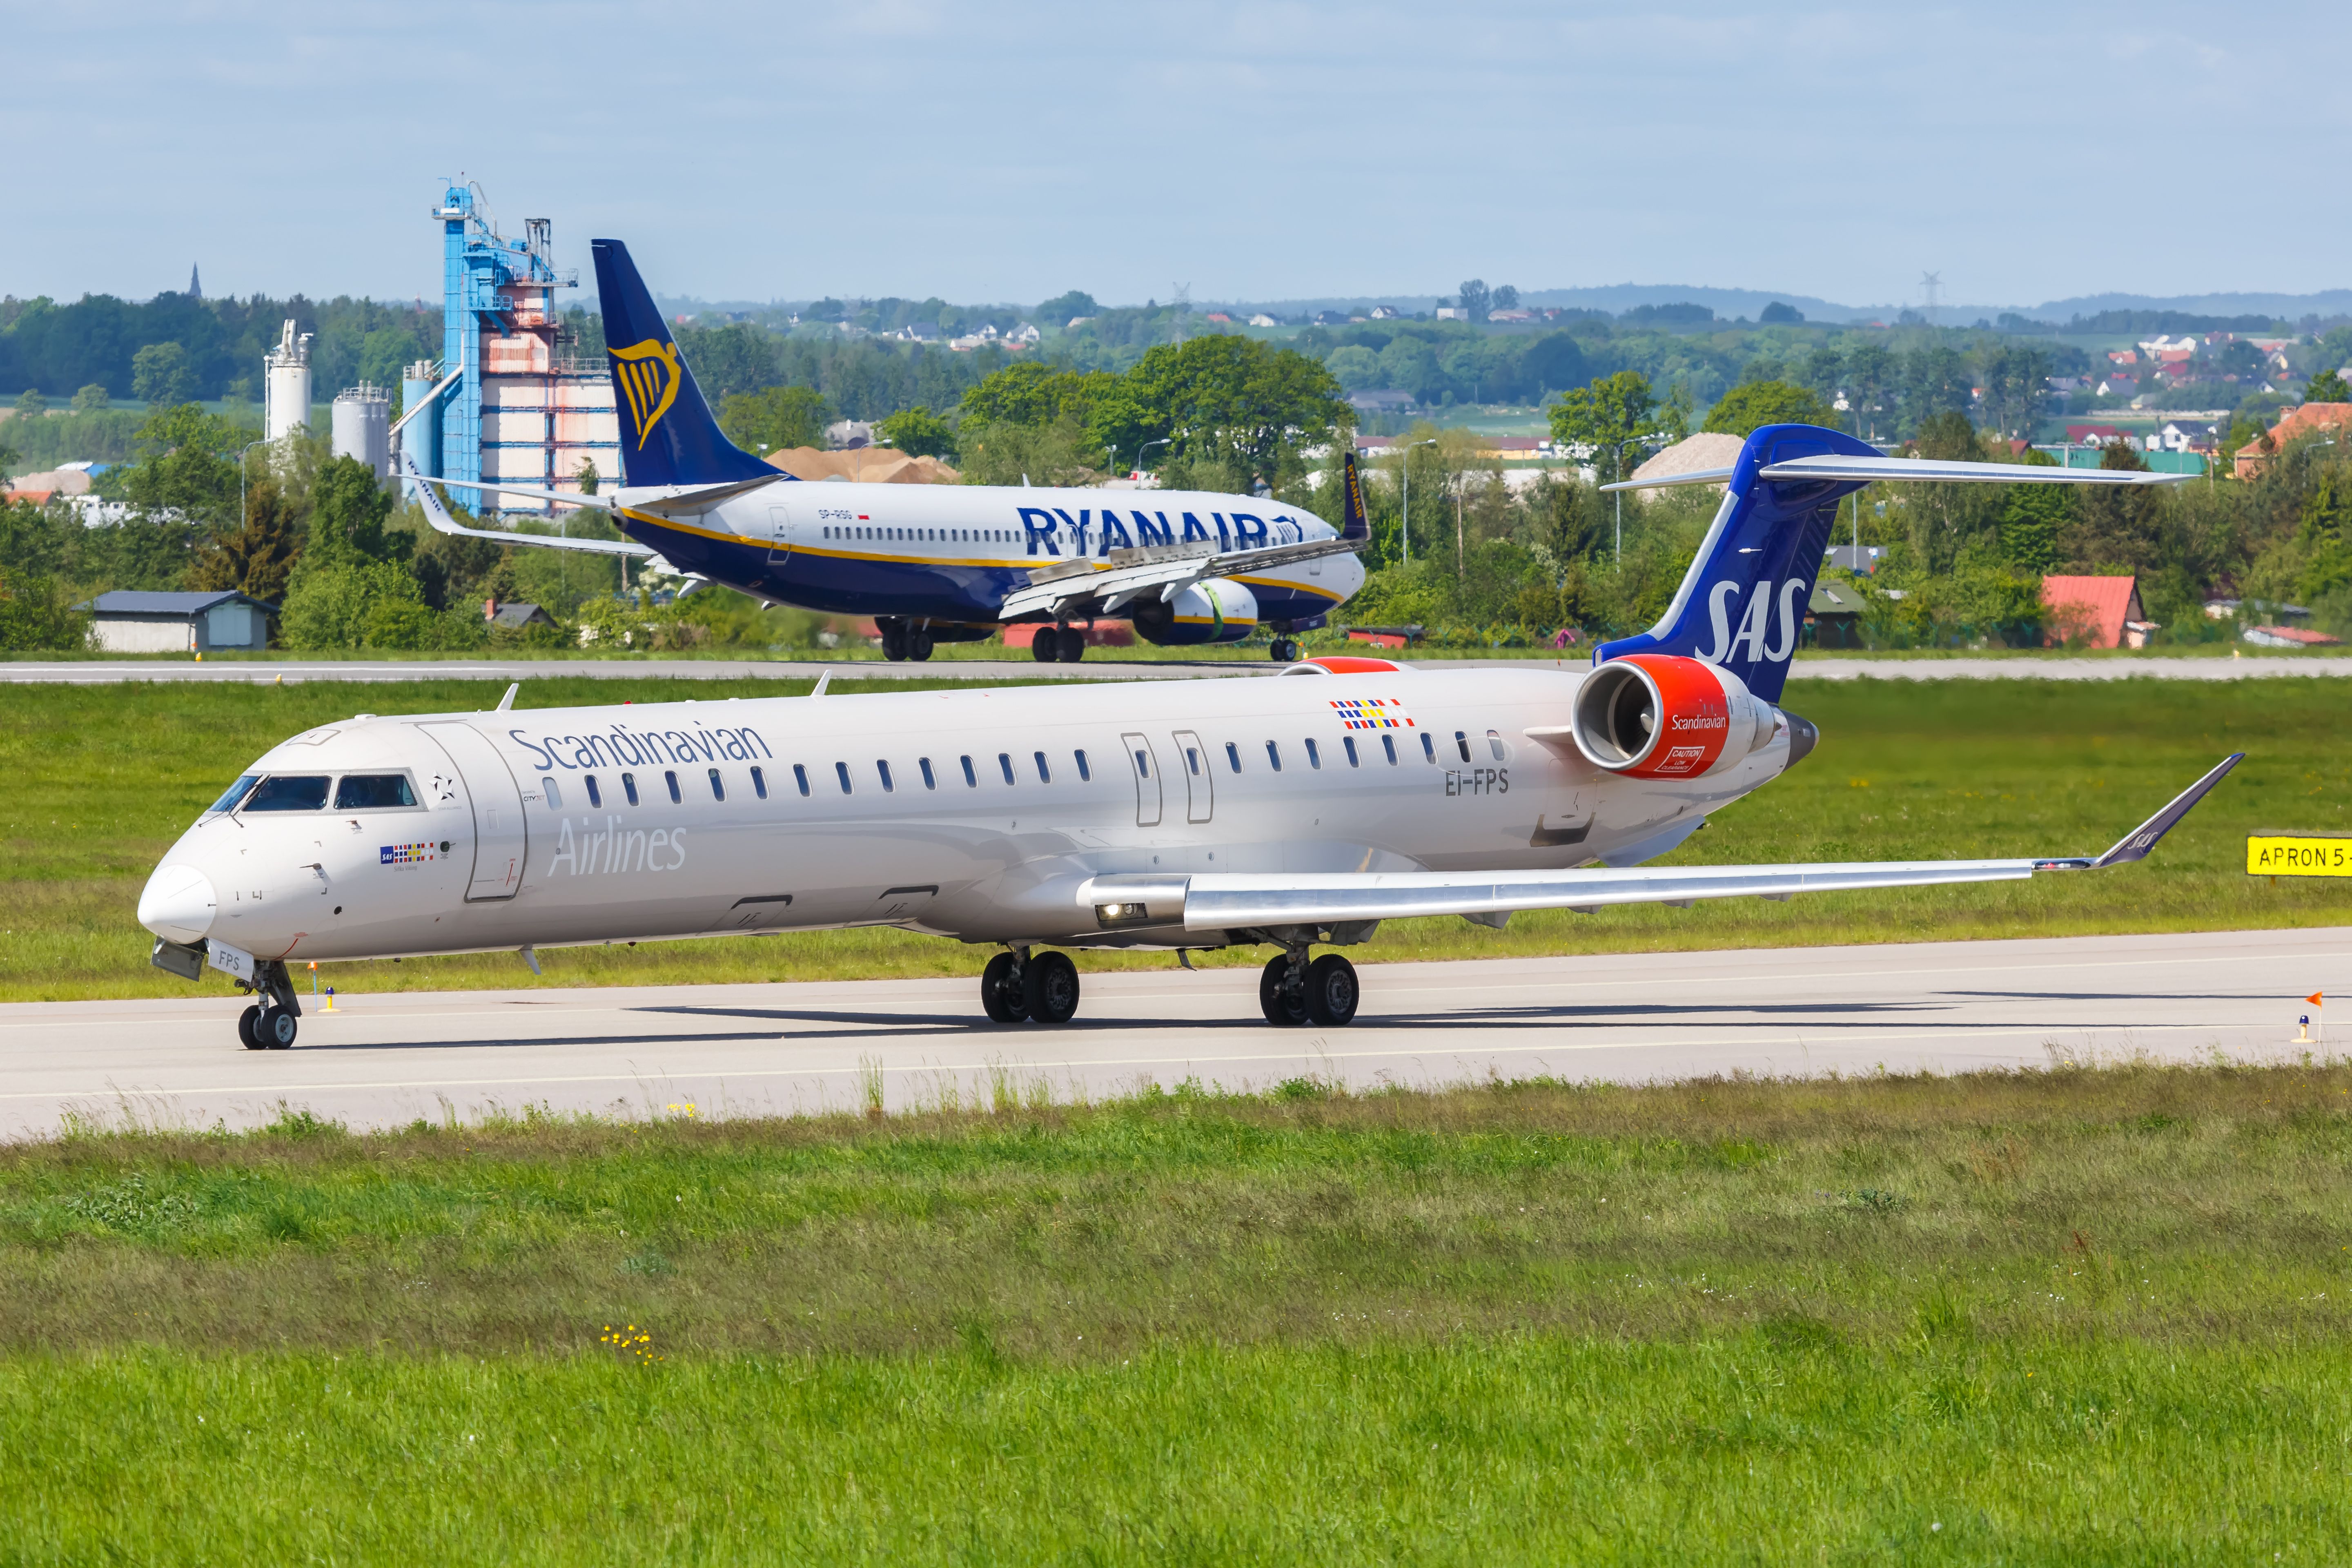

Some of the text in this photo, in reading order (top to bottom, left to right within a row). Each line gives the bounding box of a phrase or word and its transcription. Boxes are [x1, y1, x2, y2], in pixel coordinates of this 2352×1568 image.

[1347, 463, 1363, 519] RYANAIR
[818, 510, 852, 519] SP-RSG
[1016, 507, 1268, 557] RYANAIR
[1695, 577, 1806, 664] SAS
[1672, 713, 1726, 730] Scandinavian
[509, 720, 773, 771] Scandinavian
[1446, 768, 1508, 796] EI-FPS
[547, 815, 686, 878] Airlines
[2127, 831, 2158, 850] SAS
[2259, 847, 2326, 866] APRON
[219, 950, 240, 971] FPS
